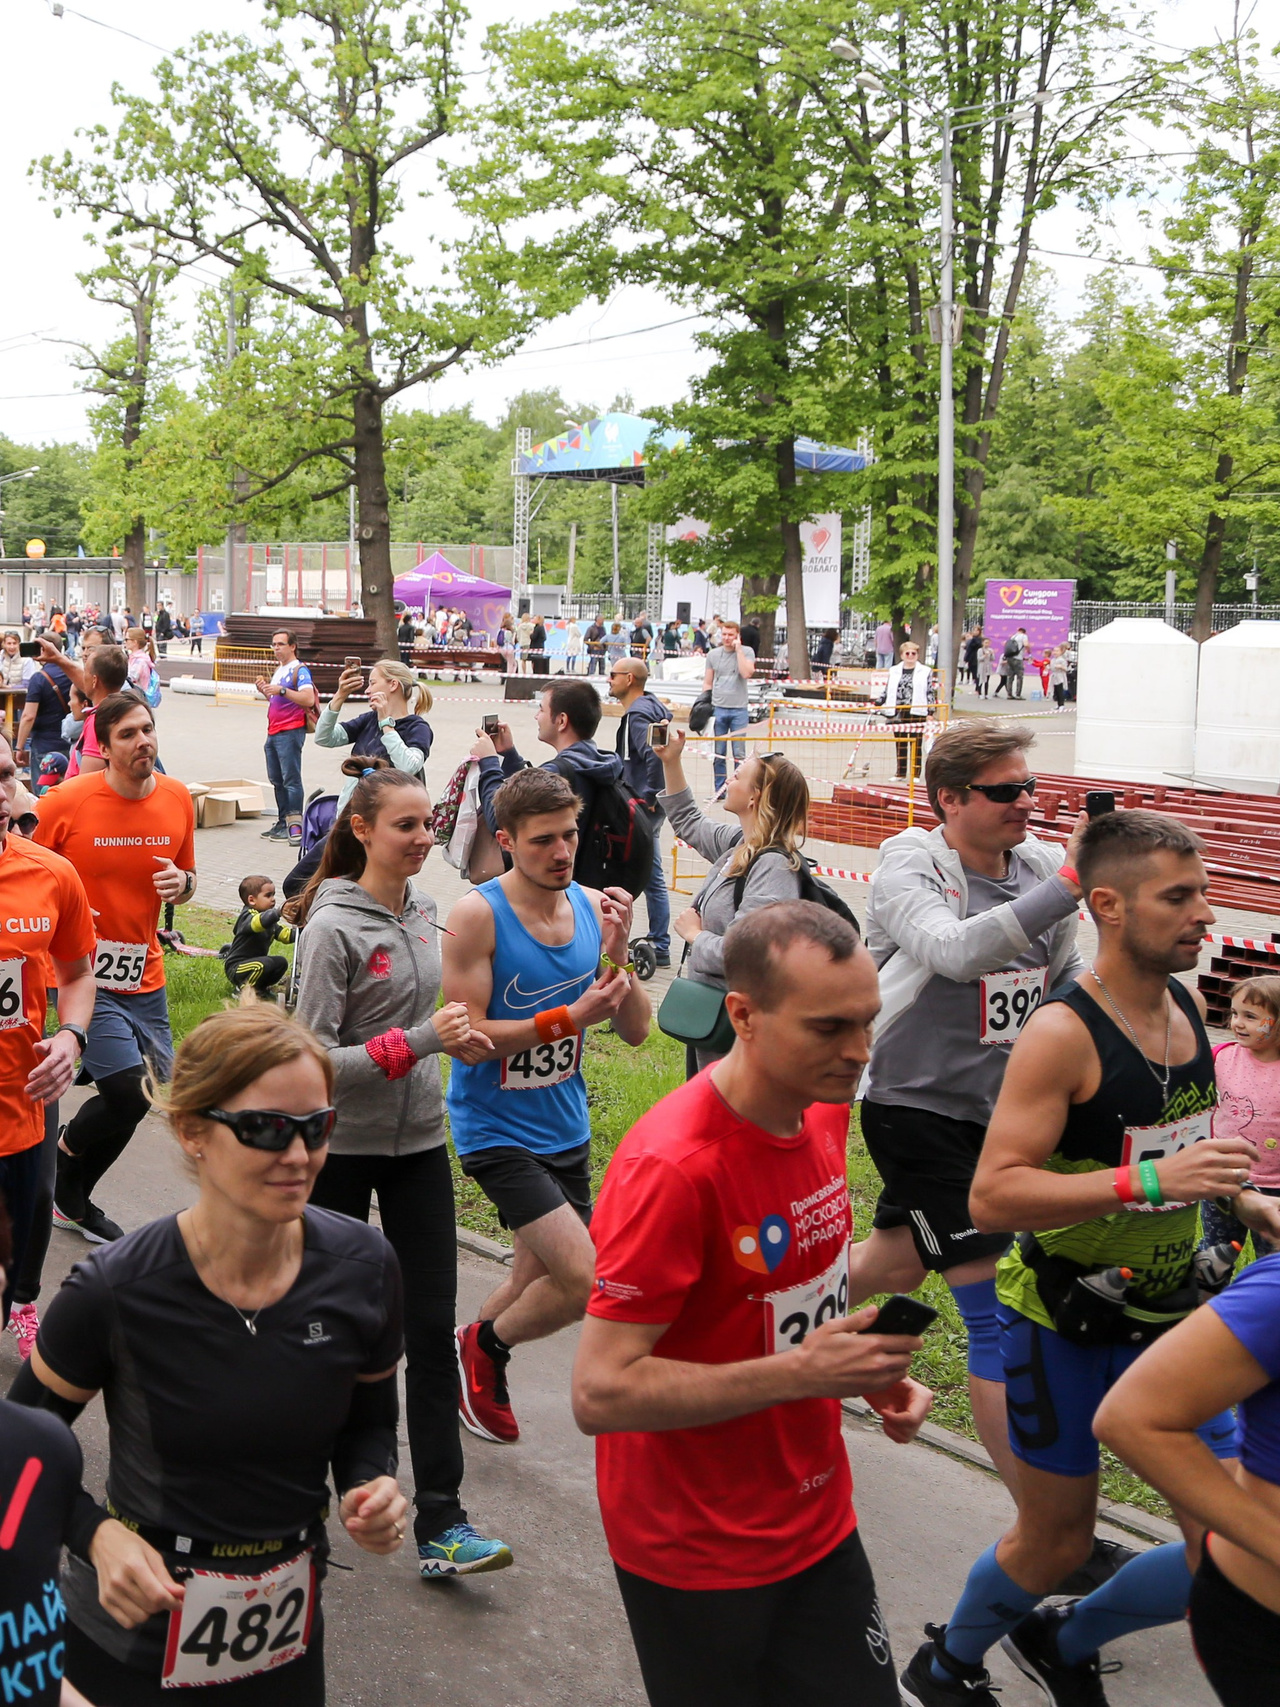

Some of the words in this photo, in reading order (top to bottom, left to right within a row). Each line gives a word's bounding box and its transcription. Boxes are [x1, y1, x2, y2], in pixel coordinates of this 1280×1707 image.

[1022, 598, 1048, 606] любви
[1023, 589, 1058, 598] Синдром
[145, 836, 171, 846] CLUB
[6, 916, 51, 933] CLUB
[95, 952, 144, 983] 255
[508, 1039, 574, 1079] 433
[180, 1587, 305, 1667] 482
